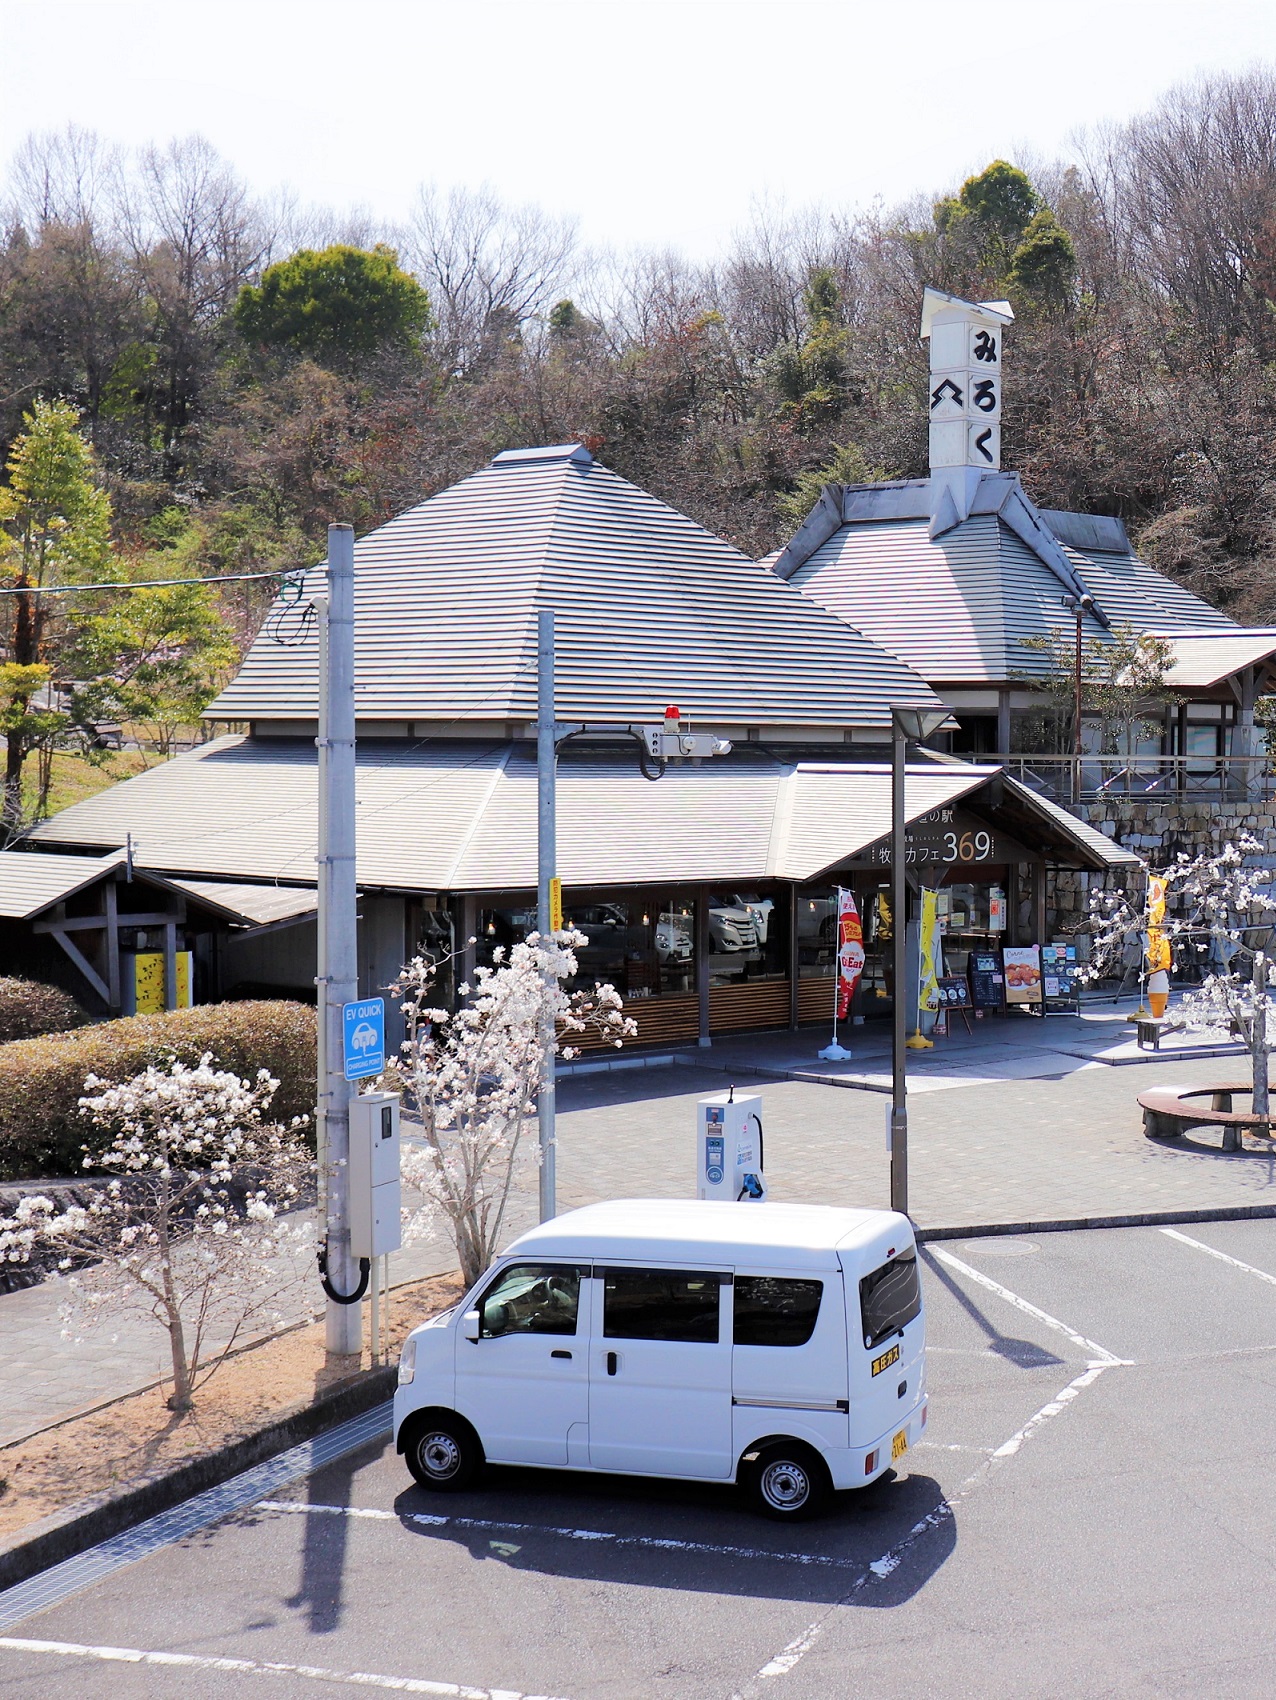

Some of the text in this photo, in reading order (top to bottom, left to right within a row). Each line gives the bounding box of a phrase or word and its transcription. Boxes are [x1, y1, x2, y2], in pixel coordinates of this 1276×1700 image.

[973, 330, 997, 463] みろく
[346, 1004, 381, 1020] EV QUICK
[872, 1347, 899, 1376] 高圧ガス
